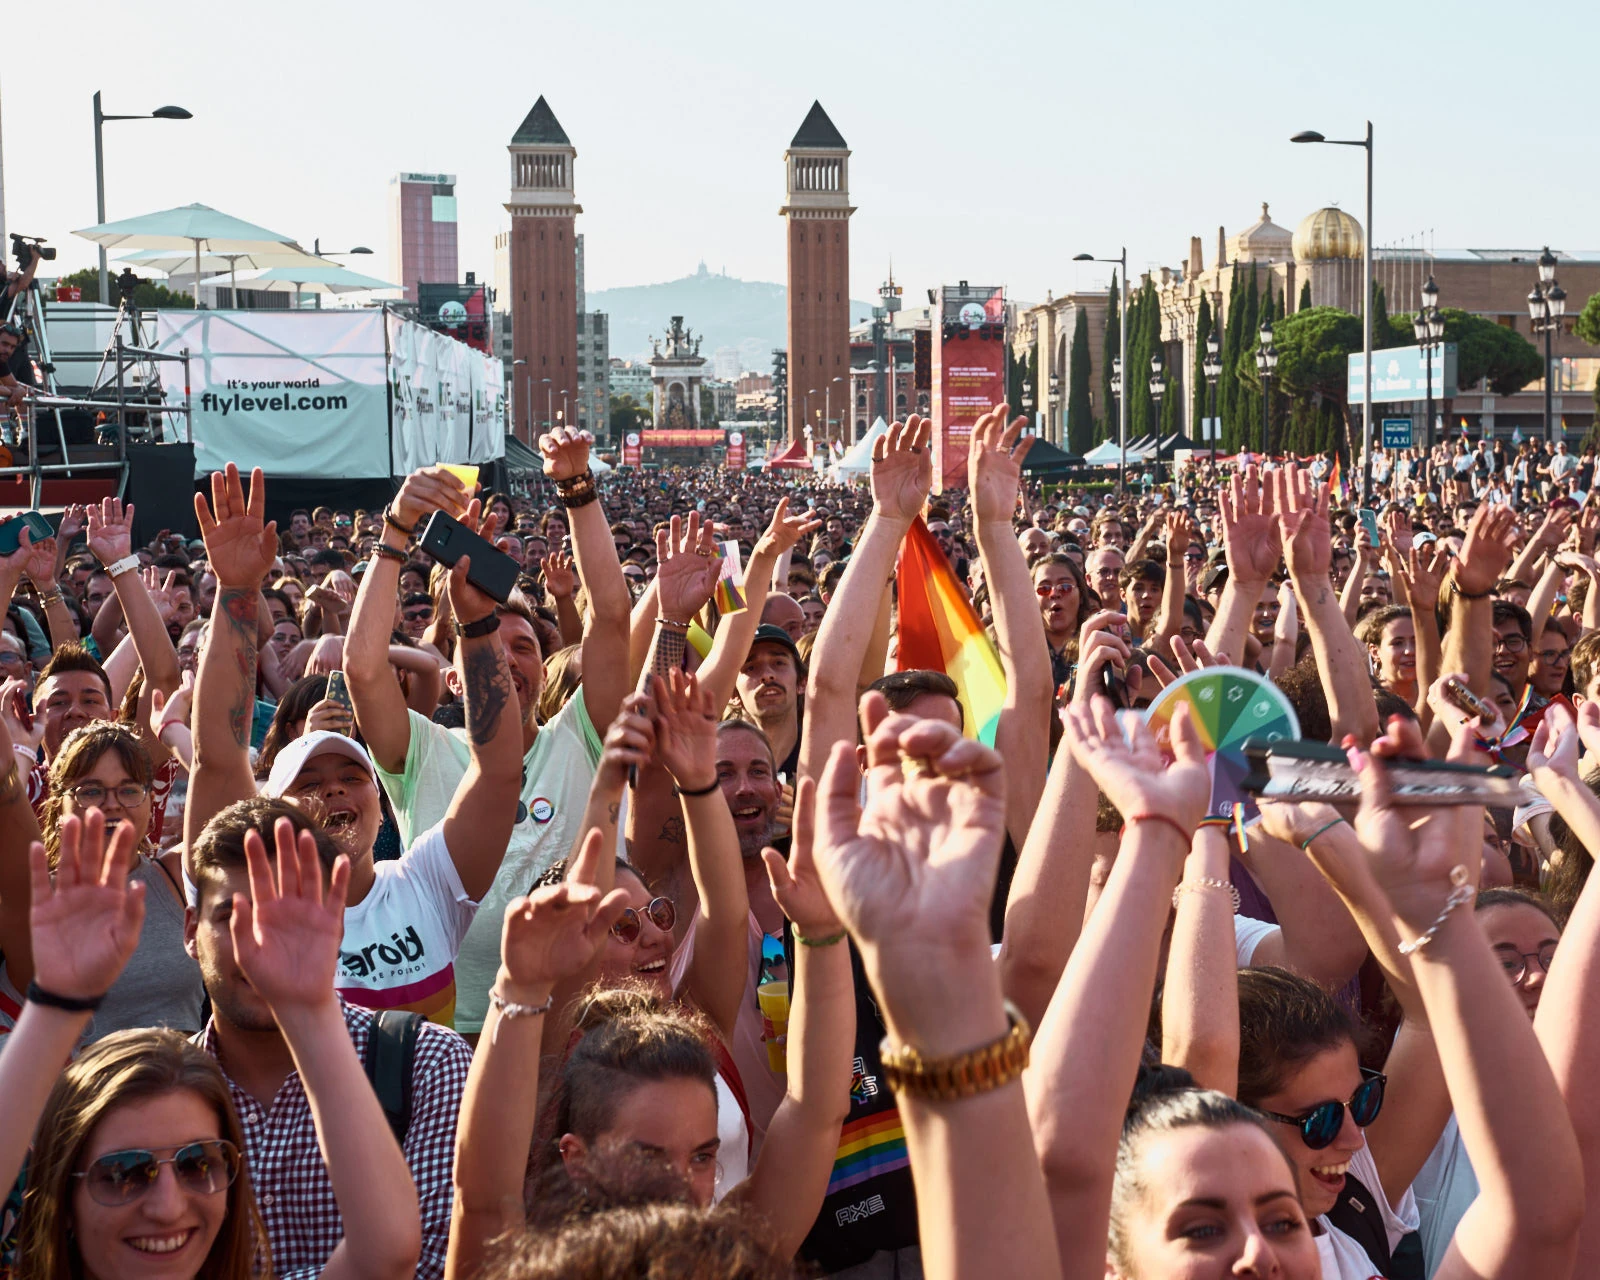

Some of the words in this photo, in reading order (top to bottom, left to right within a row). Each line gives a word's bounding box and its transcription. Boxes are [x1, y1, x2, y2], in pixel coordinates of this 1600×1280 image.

[408, 173, 436, 182] Allianz
[227, 379, 248, 390] It's
[251, 381, 281, 392] your
[284, 378, 320, 390] world
[201, 393, 347, 416] flylevel.com
[1386, 436, 1409, 445] TAXI
[338, 925, 425, 977] aroid
[835, 1194, 885, 1227] AXE
